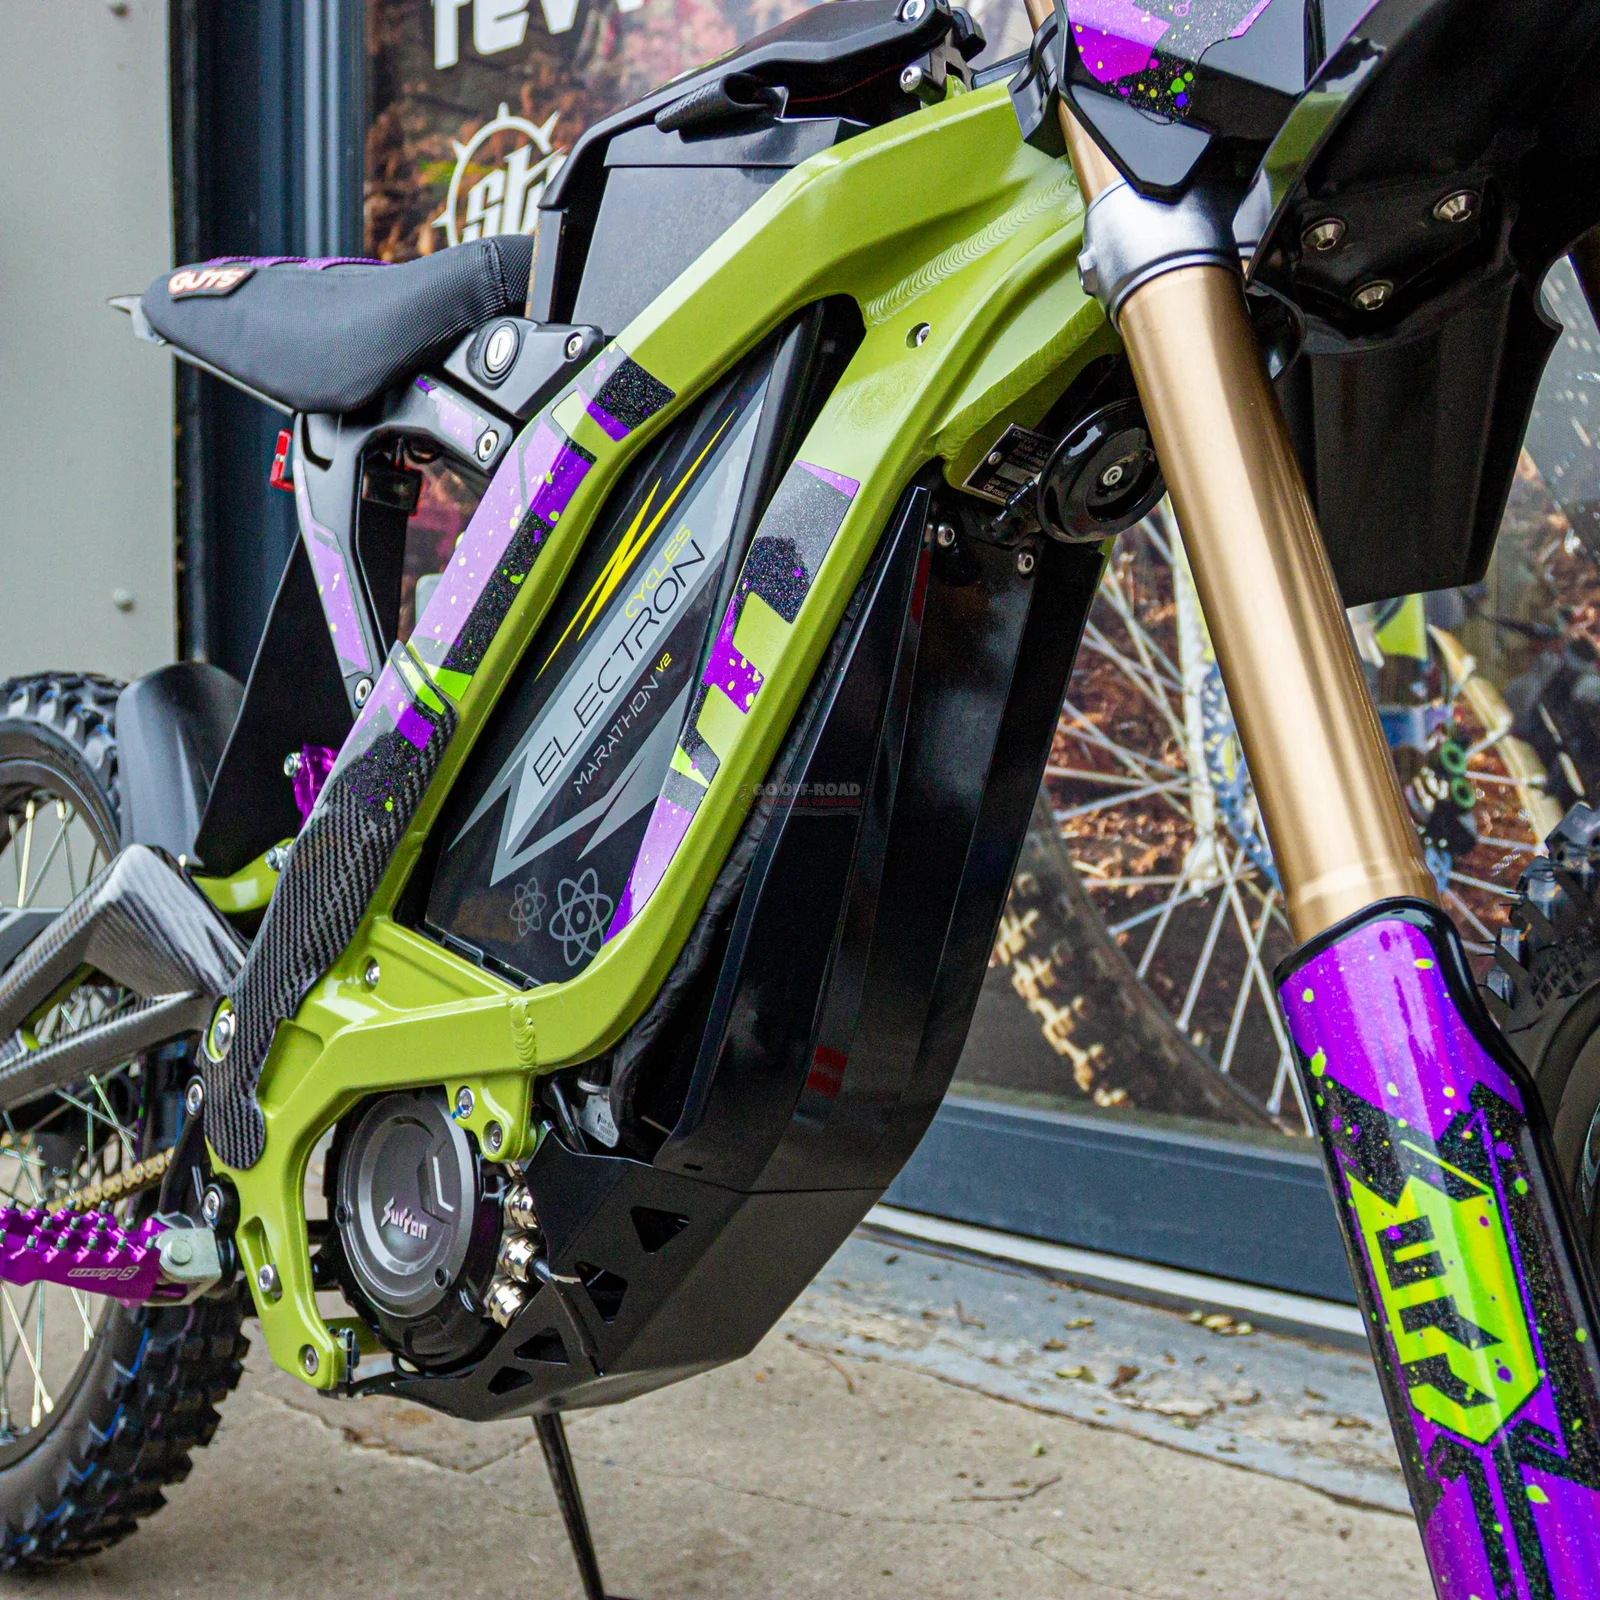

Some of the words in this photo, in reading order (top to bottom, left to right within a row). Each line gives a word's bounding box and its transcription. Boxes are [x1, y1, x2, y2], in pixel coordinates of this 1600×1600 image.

[168, 267, 247, 294] GUTS
[624, 523, 691, 620] CYCLES
[532, 538, 706, 787] ELECTRON
[572, 674, 660, 795] MARATHON
[655, 652, 673, 673] V2
